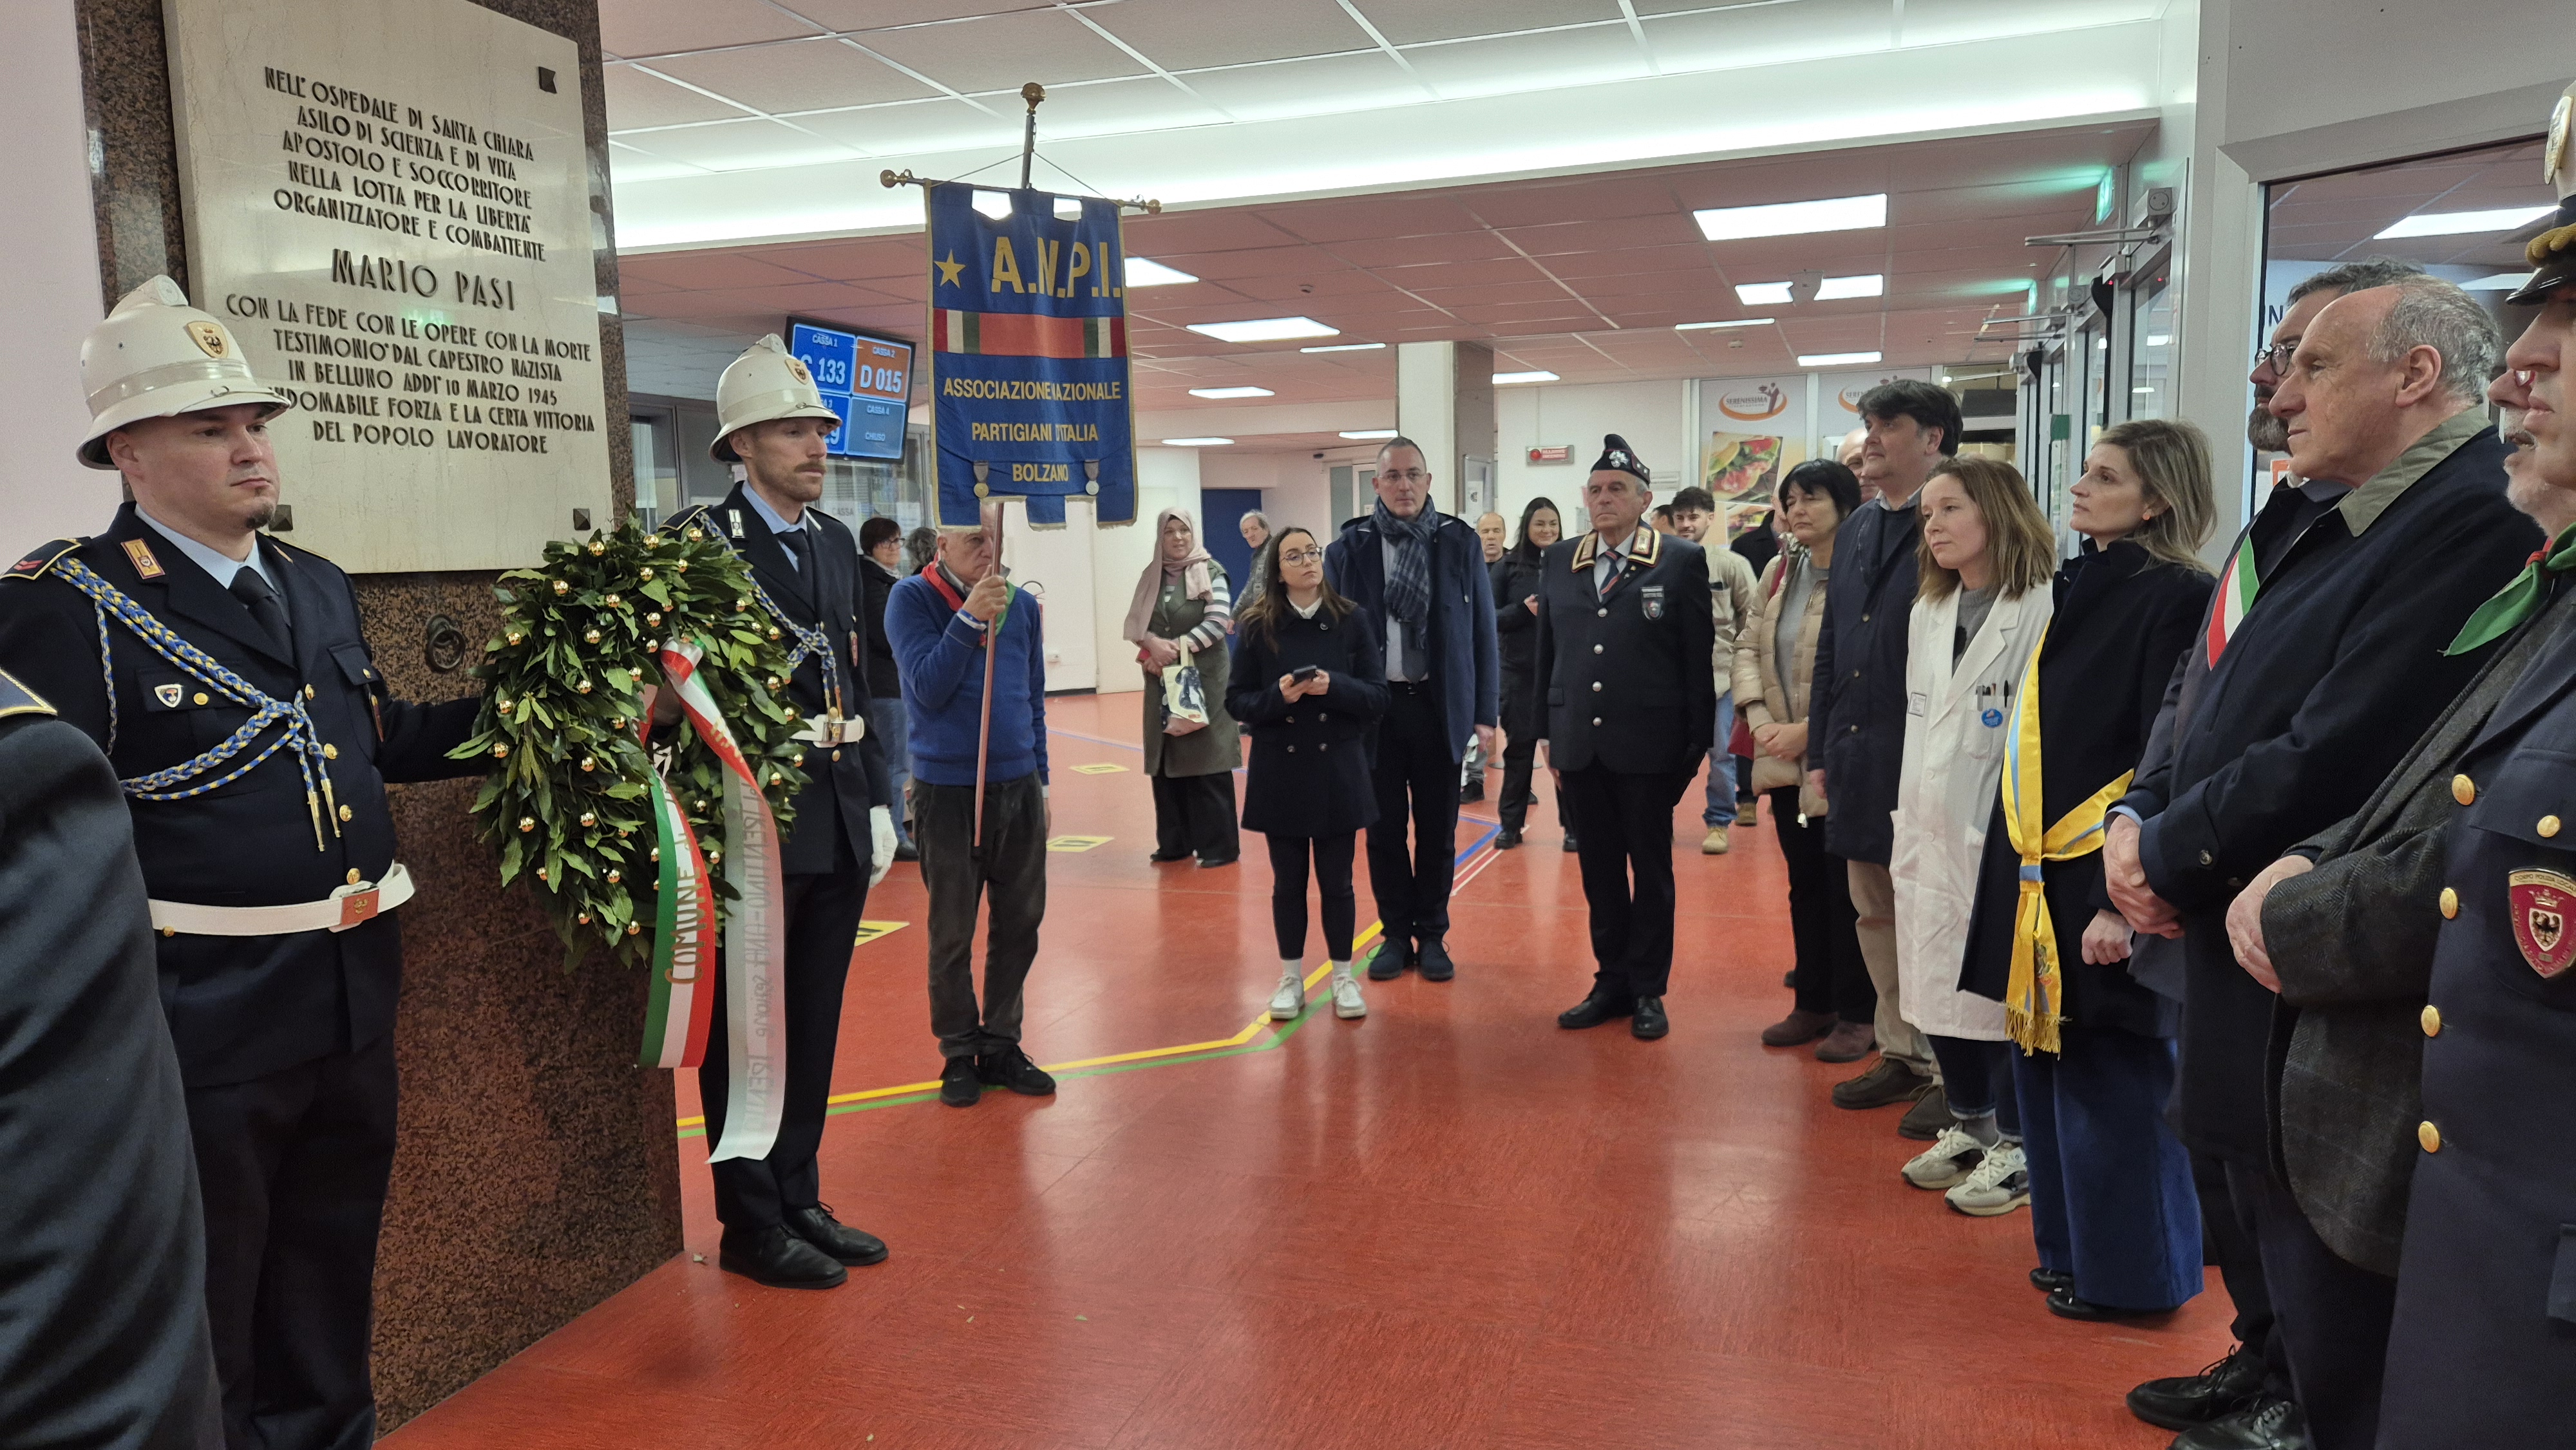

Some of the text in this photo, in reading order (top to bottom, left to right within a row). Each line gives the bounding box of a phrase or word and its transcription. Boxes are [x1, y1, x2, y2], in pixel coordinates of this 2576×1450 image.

[298, 106, 516, 181] ASILO DI SCIENZA E DI VITA
[408, 107, 423, 130] DI
[433, 115, 477, 146] SANTA
[484, 131, 534, 162] CHIARA
[283, 131, 532, 210] APOSTOLO E SOCCORRITORE
[289, 160, 341, 191] NELLA
[354, 176, 406, 206] LOTTA
[415, 191, 441, 214] PER
[450, 199, 467, 221] LA
[274, 189, 545, 261] ORGANIZZATORE E COMBATTENTE
[331, 249, 515, 311] MARIO PASI
[991, 236, 1121, 298] A.N.P.I.
[227, 294, 591, 362] CON LA FEDE CON LE OPERE CON LA MORTE
[812, 333, 838, 347] CASSA 1
[393, 344, 422, 367] DAL
[428, 350, 504, 375] CAPESTRO
[512, 359, 562, 381] NAZISTA
[817, 357, 846, 385] 133
[873, 346, 896, 359] CASSA 2
[289, 360, 305, 381] IN
[315, 362, 393, 390] BELLUNO
[446, 379, 460, 396] 10
[467, 379, 519, 402] MARZO
[529, 388, 558, 406] 1945
[860, 364, 902, 393] D 015
[943, 378, 1052, 400] ASSOCIAZIONE
[388, 398, 442, 421] FORZA
[450, 403, 460, 422] E
[464, 404, 482, 424] LA
[489, 407, 528, 427] CERTA
[534, 410, 595, 433] VITTORIA
[867, 405, 890, 415] CASSA 4
[314, 420, 549, 454] DEL POPOLO LAVORATORE
[972, 423, 1052, 442] PARTIGIANI
[1012, 464, 1068, 482] BOLZANO
[664, 867, 706, 984] COMUNE
